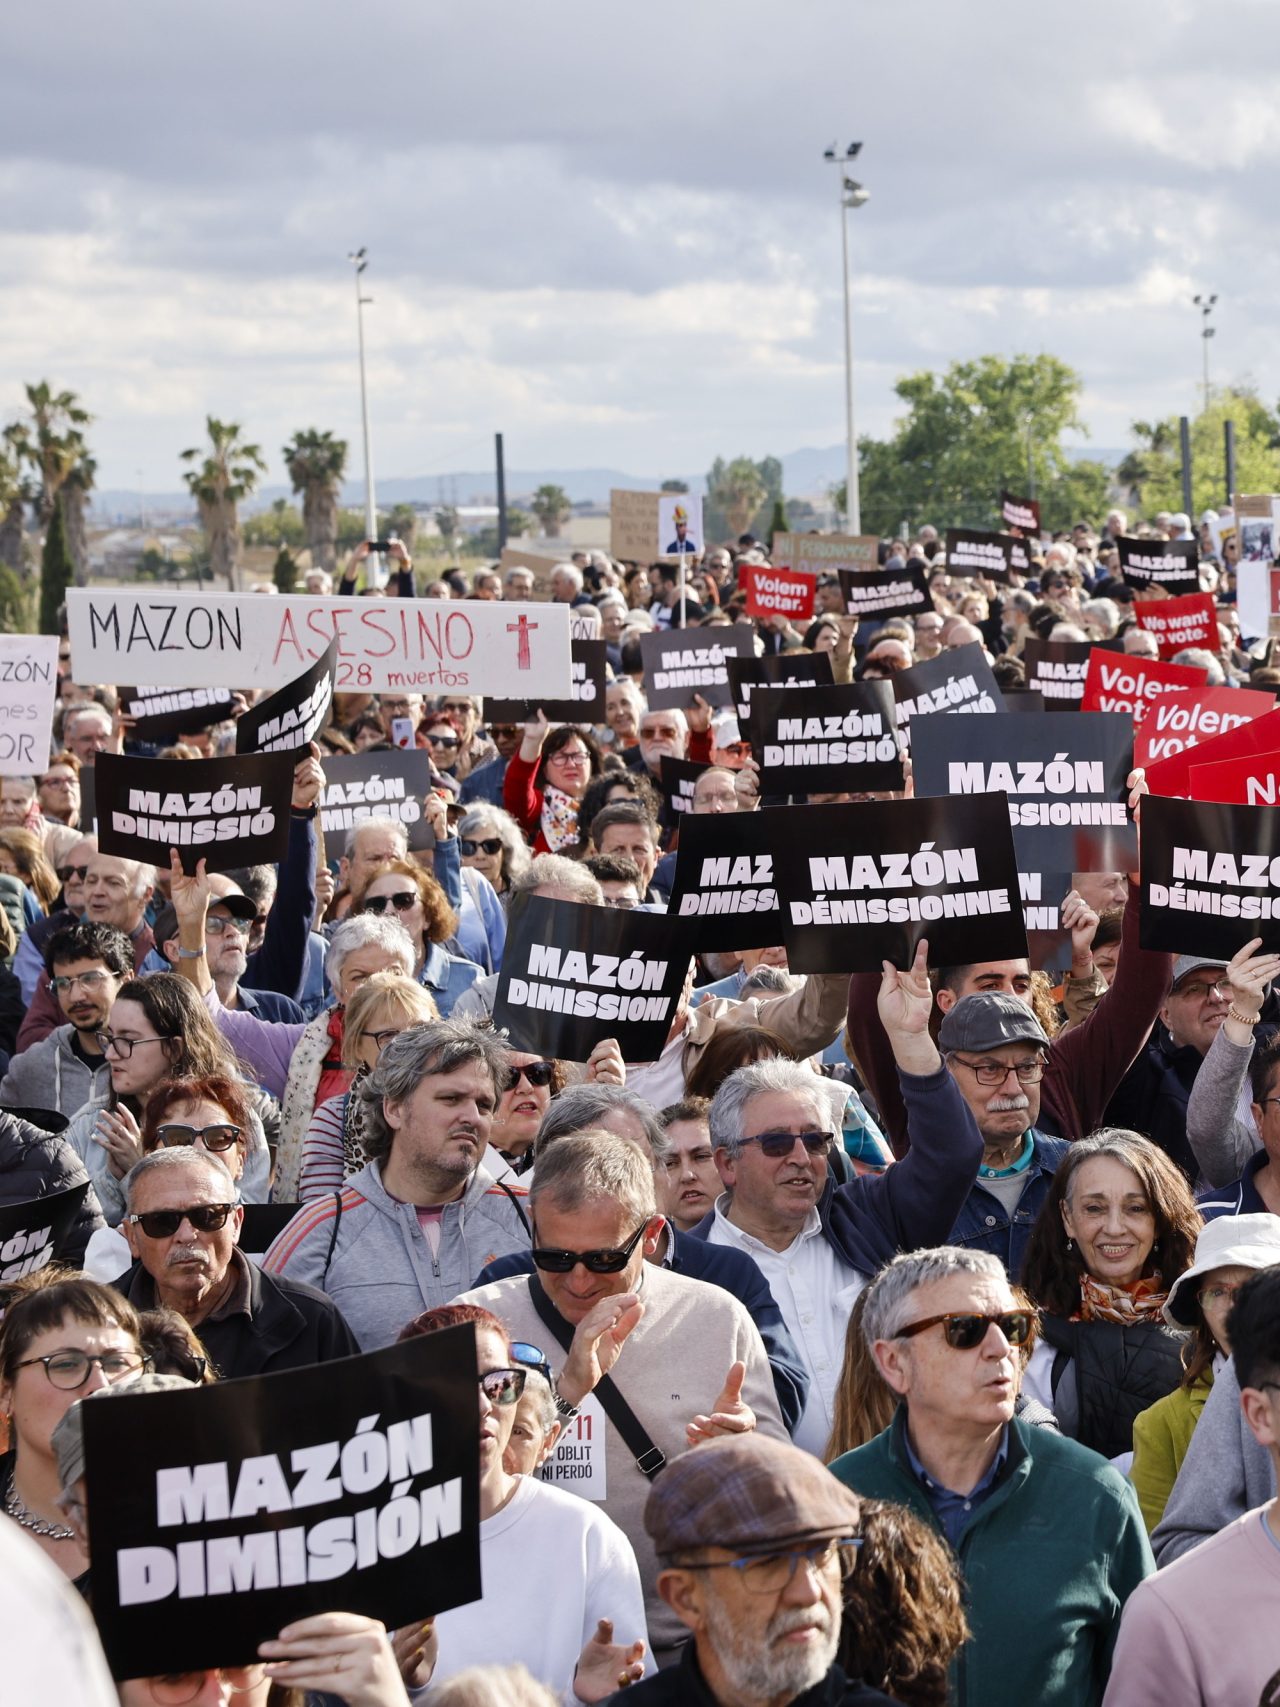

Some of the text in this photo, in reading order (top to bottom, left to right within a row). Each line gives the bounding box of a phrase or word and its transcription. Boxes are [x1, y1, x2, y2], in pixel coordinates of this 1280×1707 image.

[1128, 553, 1187, 571] MAZÓN
[753, 574, 808, 597] Volem
[851, 581, 914, 601] MAZÓN
[755, 593, 804, 612] votar.
[89, 602, 475, 665] MAZON ASESINO
[1142, 610, 1209, 631] We want
[1167, 627, 1207, 645] vote.
[387, 661, 470, 687] muertos
[895, 674, 980, 726] MAZÓN
[777, 709, 883, 741] MAZÓN
[764, 734, 897, 768] DIMISSIÓ
[948, 753, 1105, 794] MAZÓN
[128, 783, 262, 816] MAZÓN
[321, 774, 406, 807] AZÓN
[112, 805, 275, 846] DIMISSIÓ
[809, 842, 979, 892] MAZÓN
[789, 888, 1012, 927] DÉMISSIONNE
[526, 943, 668, 991] MAZÓN
[507, 978, 671, 1023] DIMISSIONI
[0, 1225, 52, 1262] ÓN
[557, 1446, 592, 1461] OBLIT
[156, 1413, 434, 1528] MAZÓN
[556, 1463, 593, 1480] PERDÓ
[117, 1477, 463, 1606] DIMISIÓN
